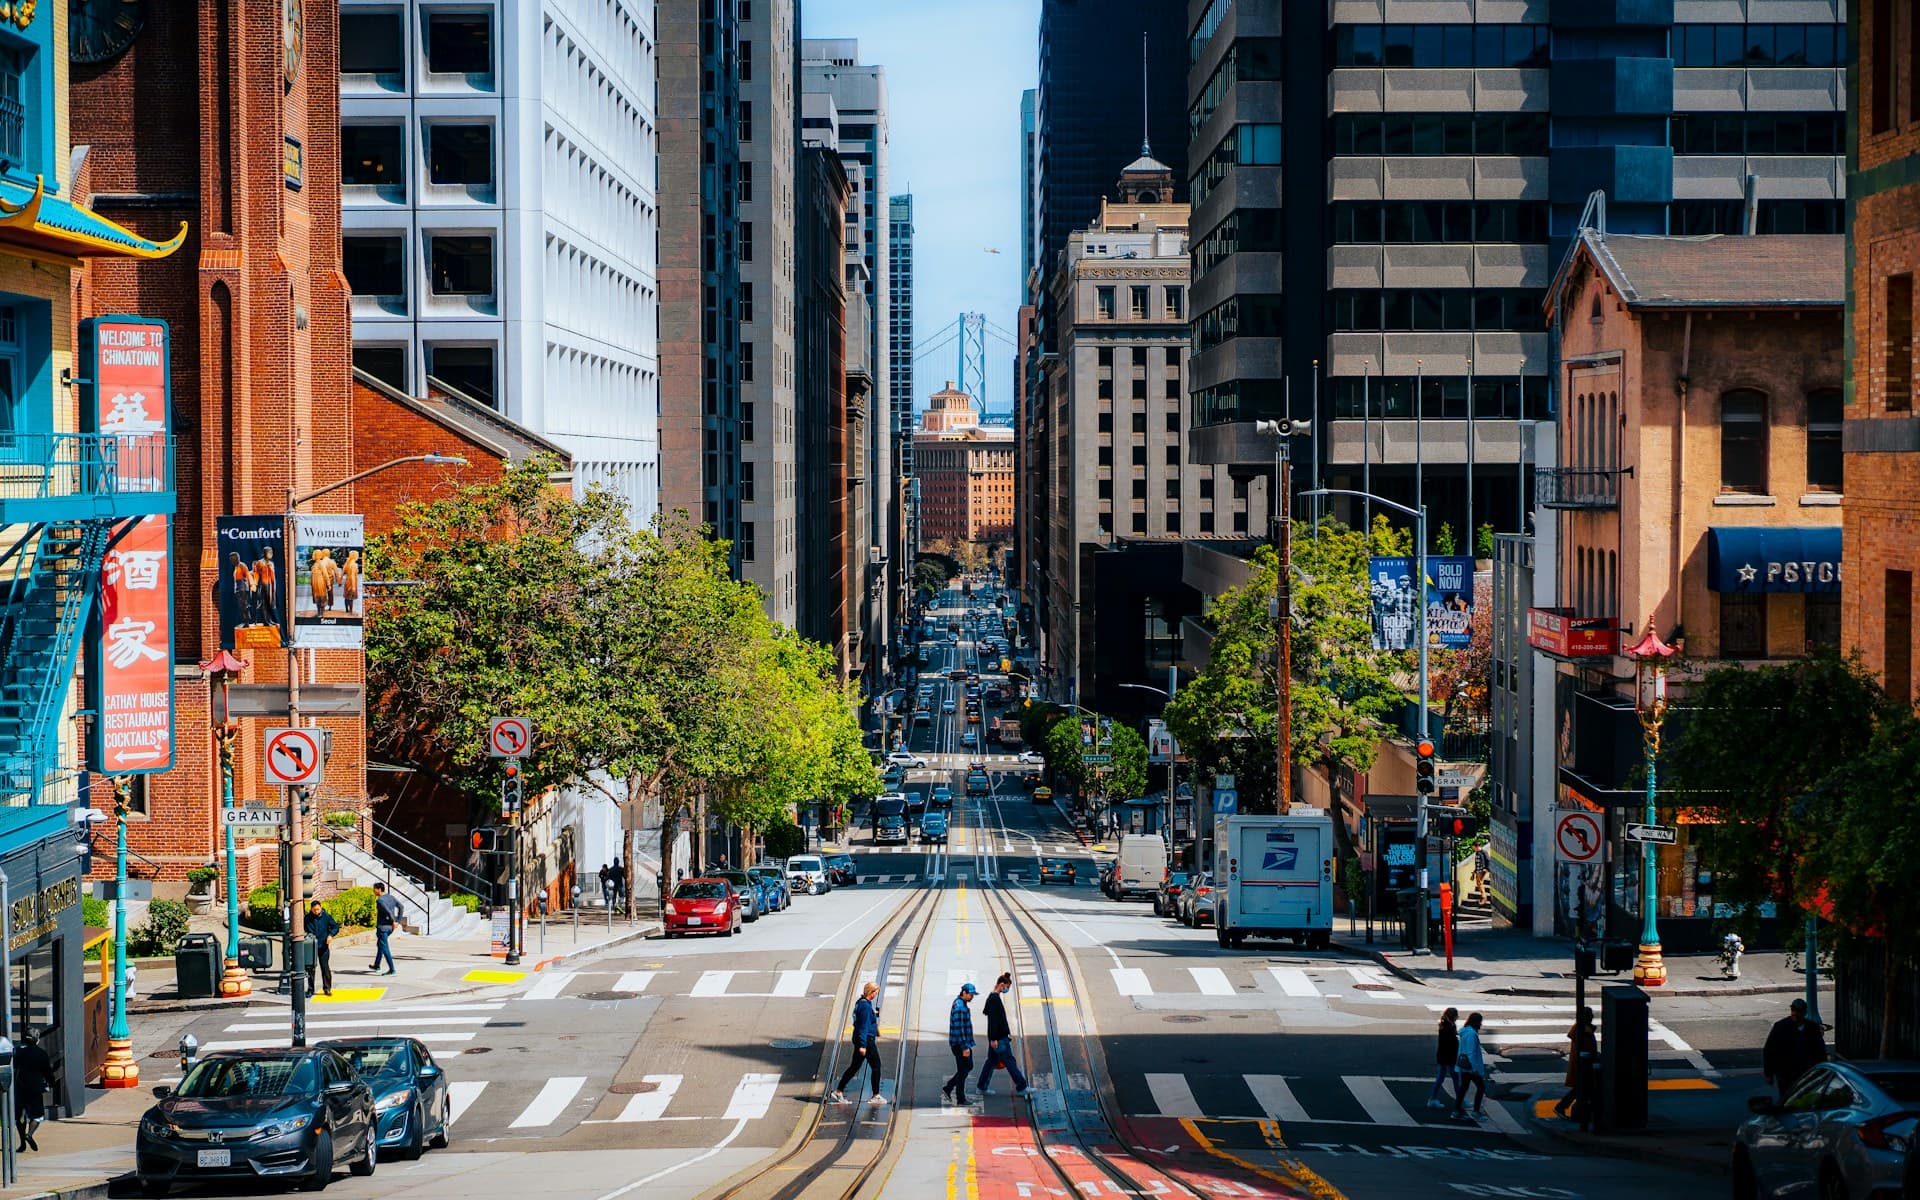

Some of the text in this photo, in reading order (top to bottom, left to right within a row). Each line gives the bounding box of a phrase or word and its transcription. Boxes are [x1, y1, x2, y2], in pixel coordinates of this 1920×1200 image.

[99, 330, 163, 347] WELCOME TO
[103, 349, 160, 367] CHINATOWN
[1438, 564, 1463, 577] BOLD
[1767, 562, 1842, 583] PSYC
[1439, 577, 1462, 590] NOW
[1383, 616, 1406, 628] BOLD
[1384, 628, 1407, 640] THEN
[104, 692, 169, 711] CATHAY HOUSE
[105, 711, 169, 729] RESTAURANT
[104, 730, 156, 748] COCKTAILS
[227, 811, 282, 822] GRANT
[38, 876, 77, 919] CORNER
[1016, 1180, 1266, 1198] MUNI
